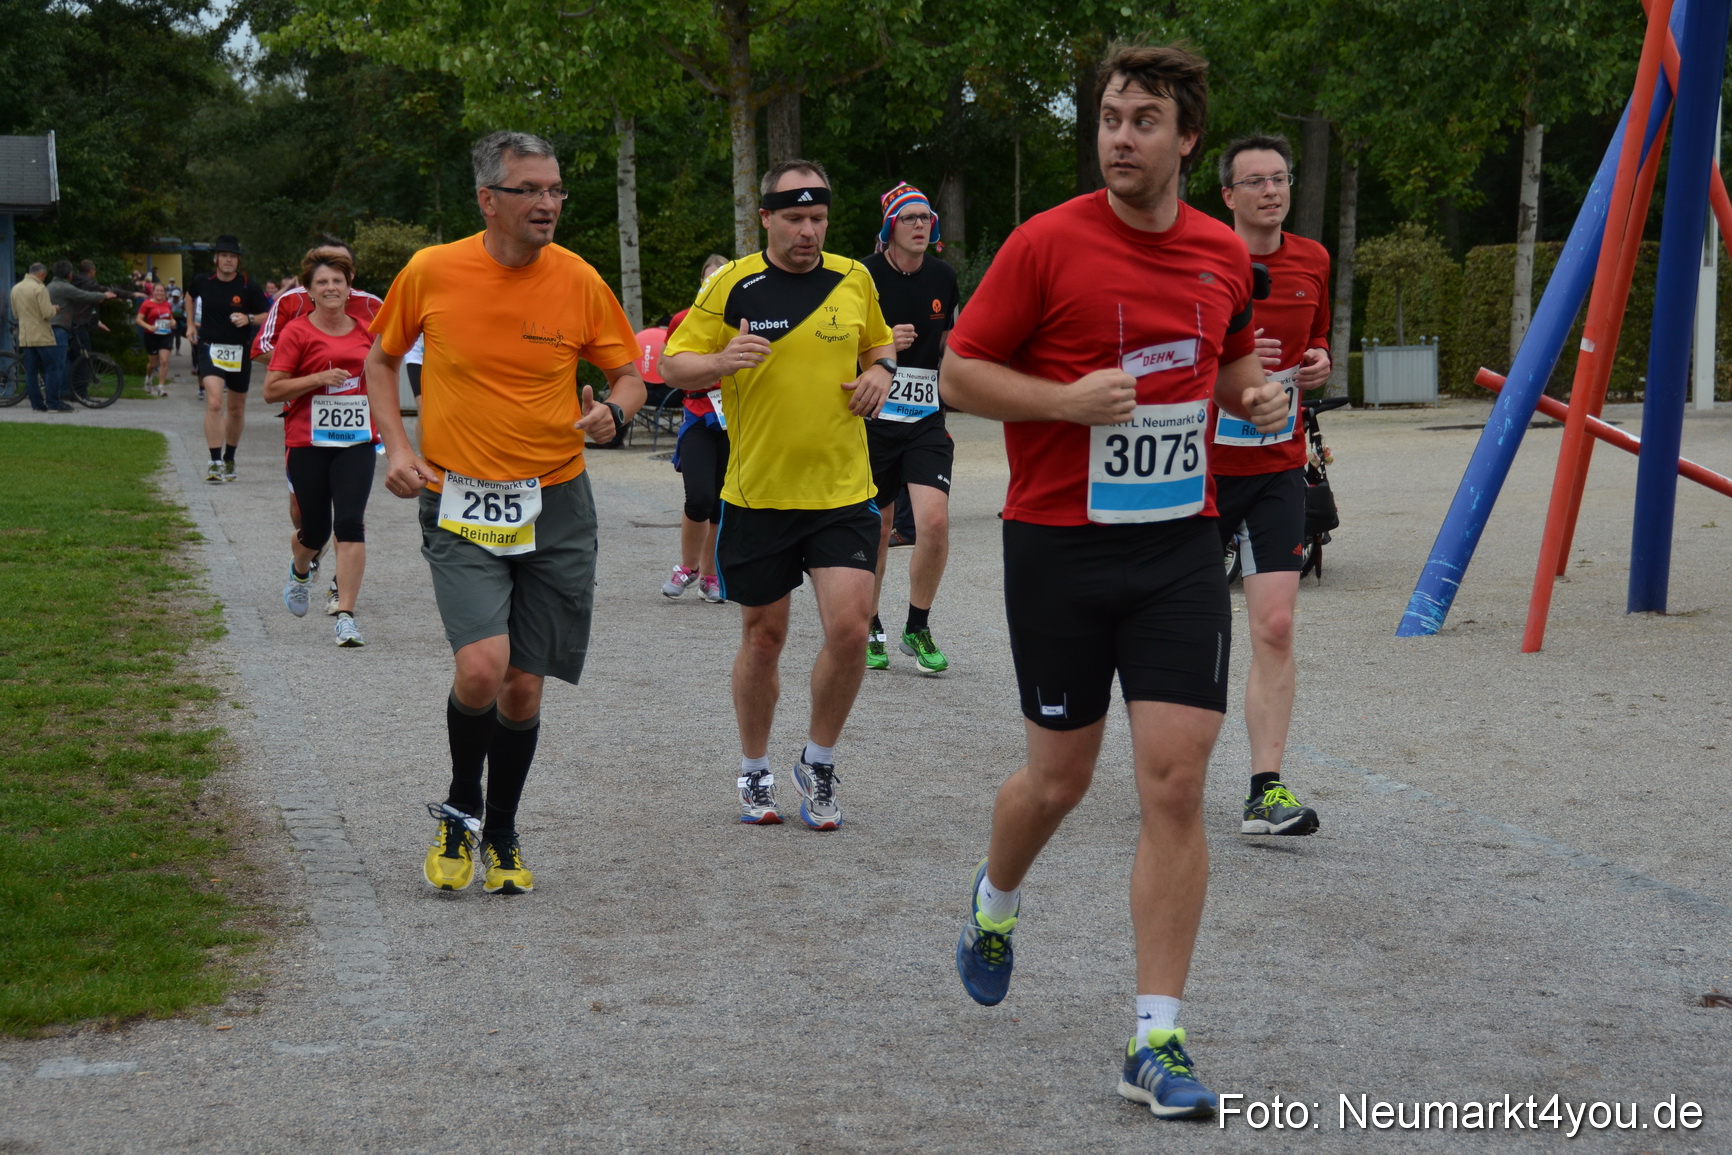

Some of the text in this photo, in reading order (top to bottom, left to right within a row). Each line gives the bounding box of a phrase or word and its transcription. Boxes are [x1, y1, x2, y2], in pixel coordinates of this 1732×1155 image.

[750, 319, 789, 331] Robert
[815, 330, 850, 343] Burgthann
[217, 349, 236, 360] 231
[1143, 350, 1175, 367] DEHN
[888, 379, 934, 404] 2458
[318, 408, 365, 428] 2625
[896, 405, 923, 416] Florian
[1142, 414, 1195, 428] Neumarkt
[328, 432, 356, 440] Monika
[1104, 429, 1199, 478] 3075
[447, 473, 523, 491] PARTL Neumarkt
[462, 491, 523, 523] 265
[460, 526, 518, 544] Reinhard
